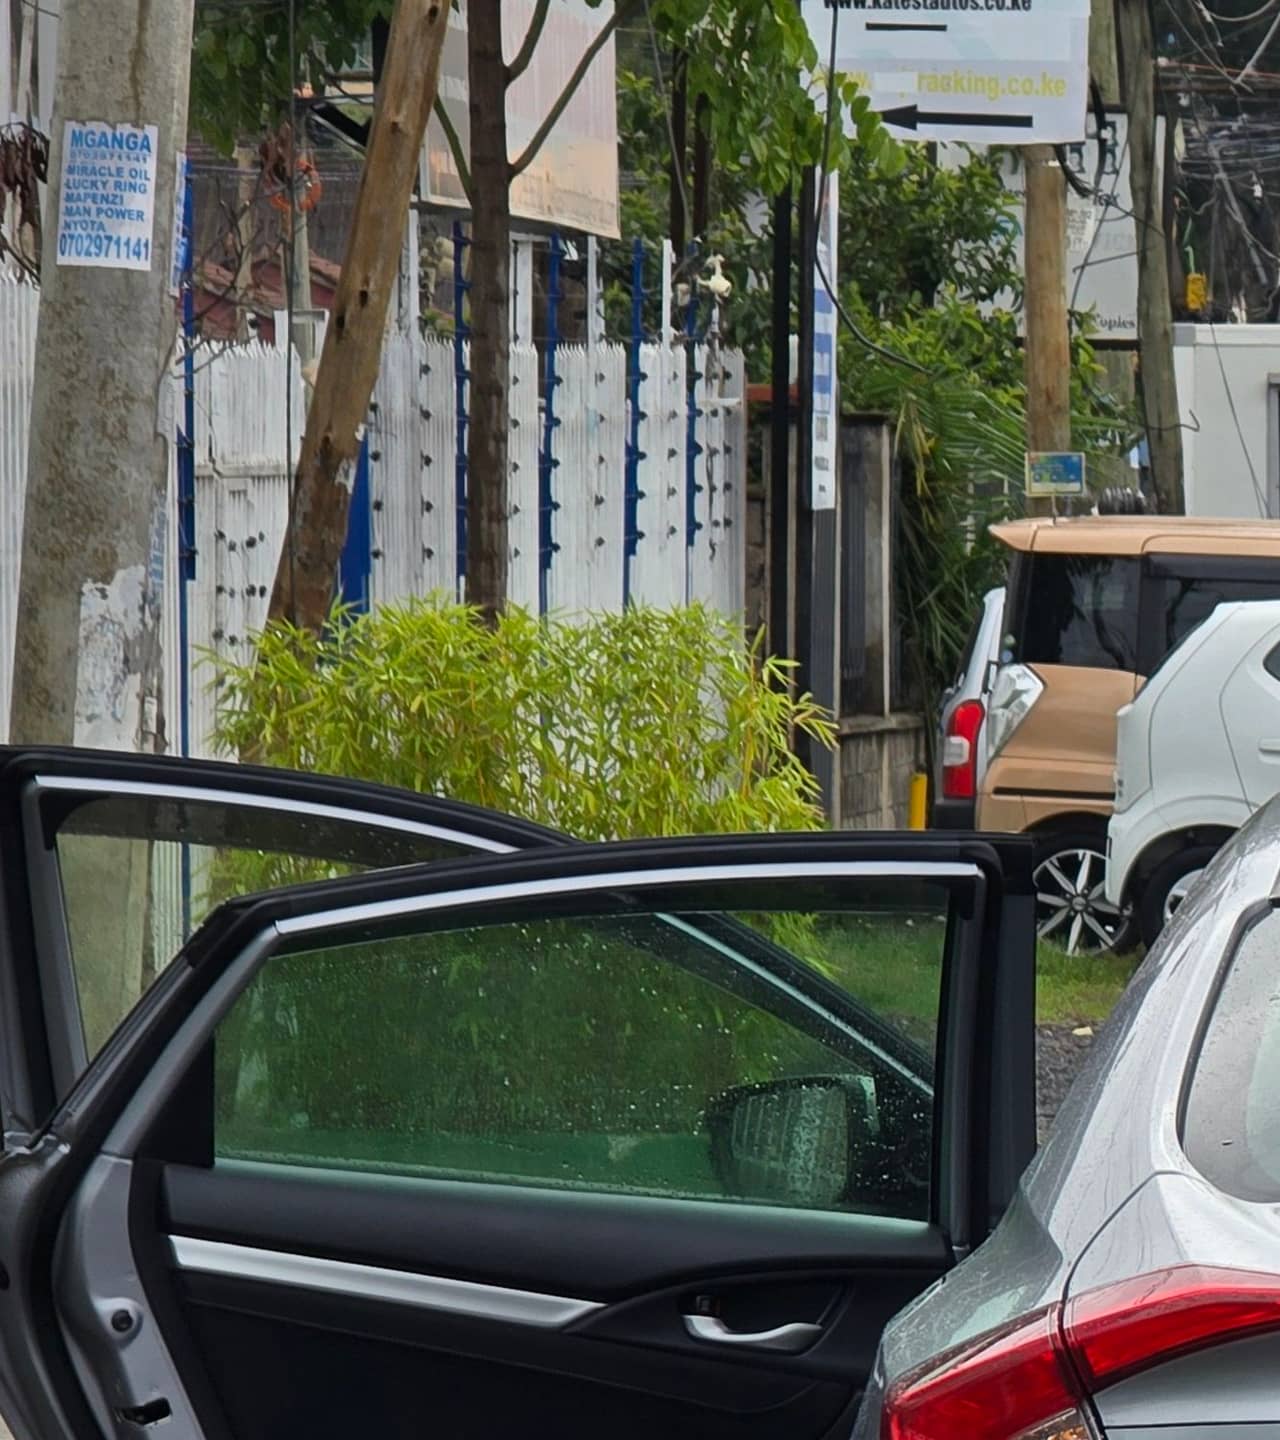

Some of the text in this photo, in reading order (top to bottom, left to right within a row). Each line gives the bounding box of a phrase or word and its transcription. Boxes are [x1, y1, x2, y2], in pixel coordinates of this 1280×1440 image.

[71, 128, 152, 153] MGANGA
[66, 164, 151, 181] MIRACLE OIL
[64, 178, 148, 194] LUCKY RING
[64, 191, 125, 206] MAPENZI
[64, 205, 146, 222] MAN POWER
[63, 219, 107, 232] NYOTA
[59, 233, 150, 262] 0702971141
